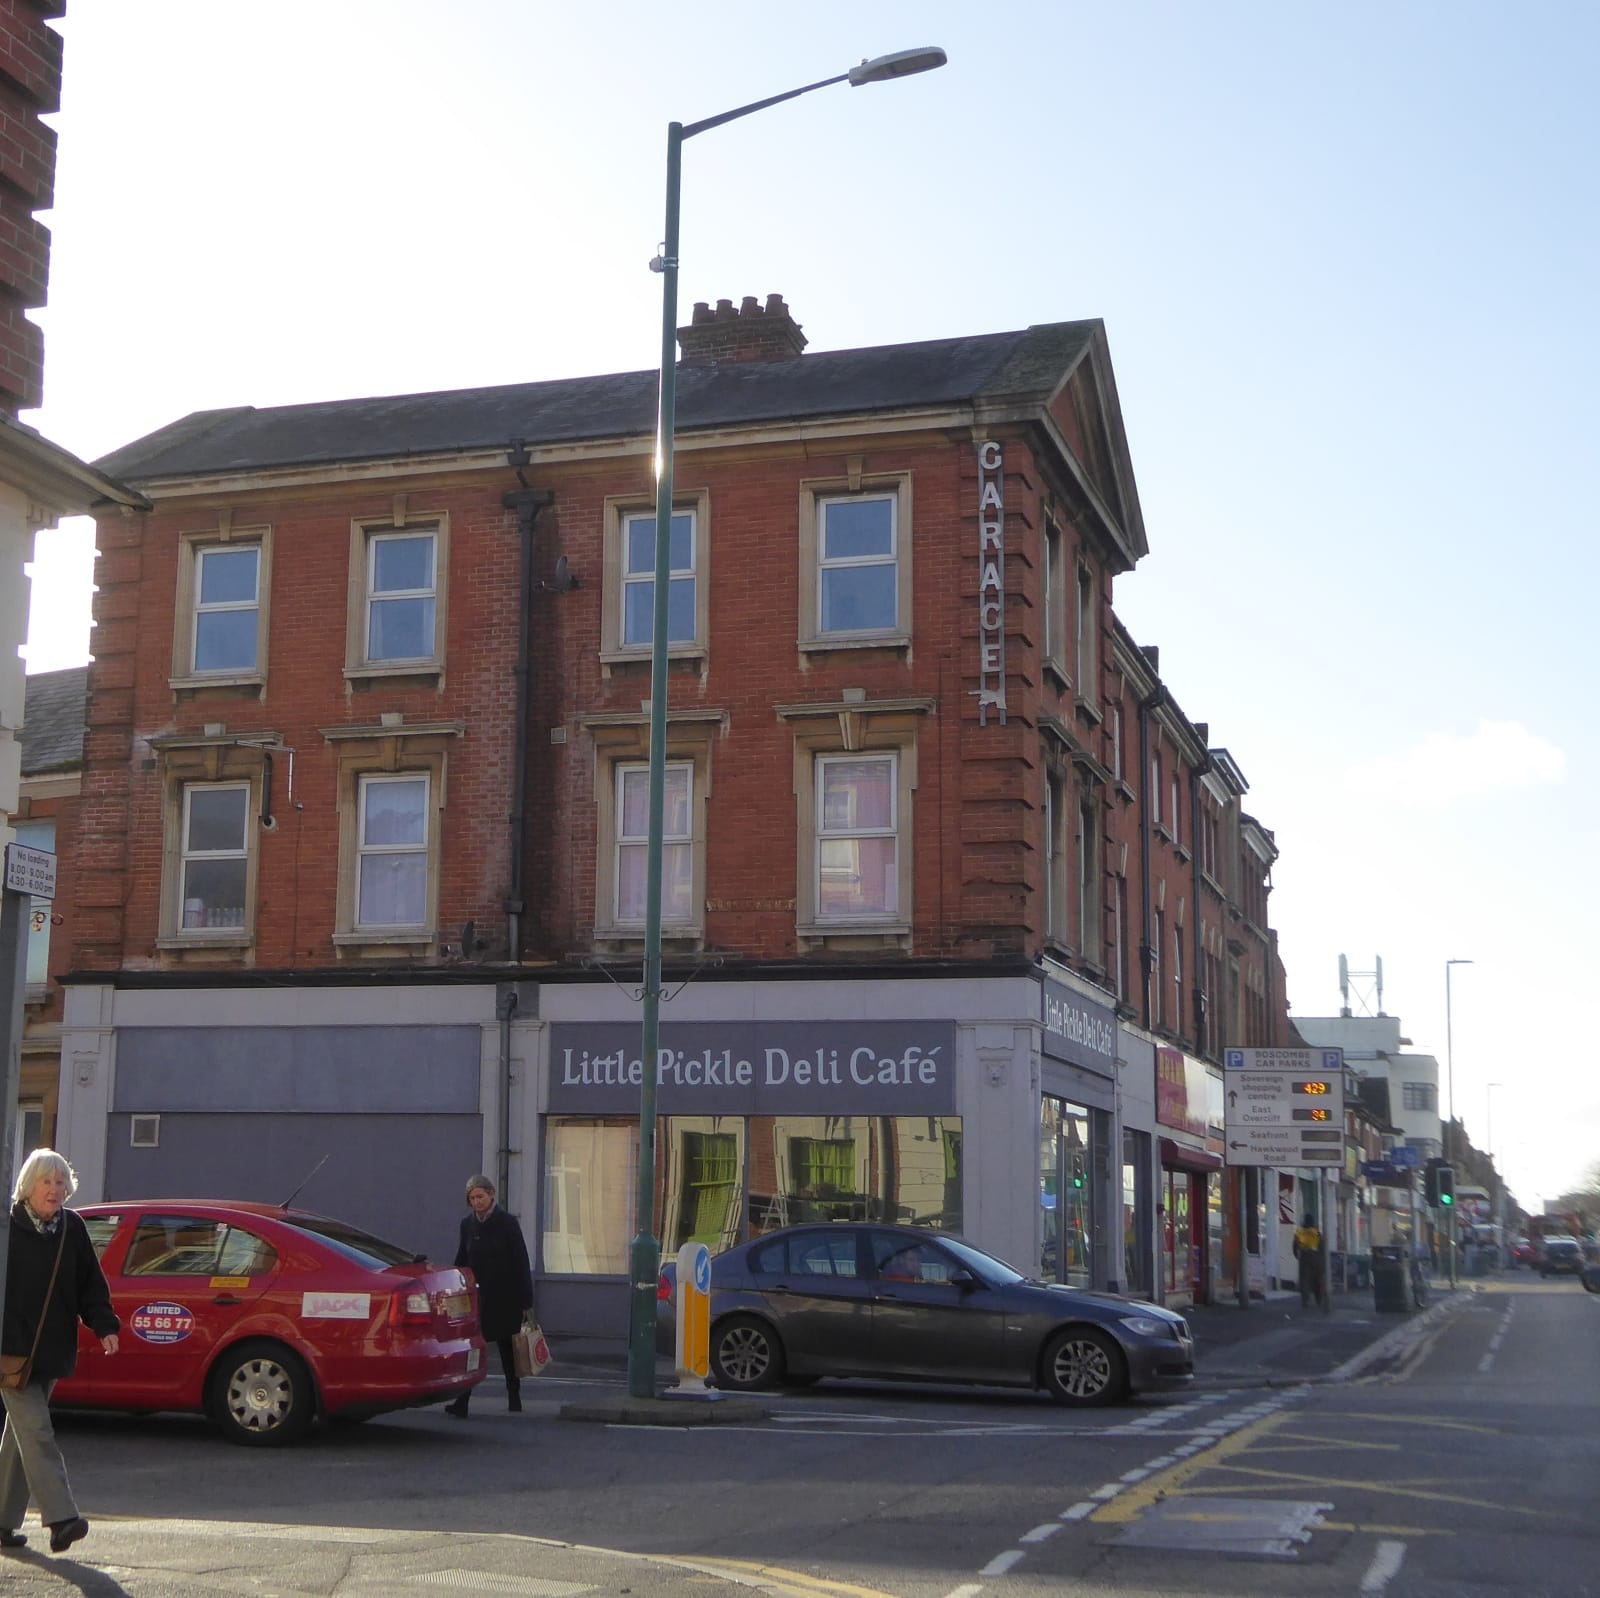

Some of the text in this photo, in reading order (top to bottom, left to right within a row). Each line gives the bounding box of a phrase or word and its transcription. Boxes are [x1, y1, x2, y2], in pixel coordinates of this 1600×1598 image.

[979, 441, 1003, 672] GARAGE
[17, 850, 49, 868] No loading
[1045, 994, 1062, 1035] Little
[1063, 1002, 1083, 1044] Pickle
[1083, 1012, 1097, 1050] Deli
[1255, 1050, 1310, 1059] BOSCOMBE
[561, 1046, 941, 1085] Little Pickle Deli Café
[1279, 1060, 1311, 1068] PARKS
[1252, 1105, 1271, 1113] East
[1250, 1131, 1289, 1139] Seafront
[1264, 1154, 1286, 1162] Road
[147, 1306, 181, 1315] UNITED
[135, 1317, 192, 1329] 55 66 77
